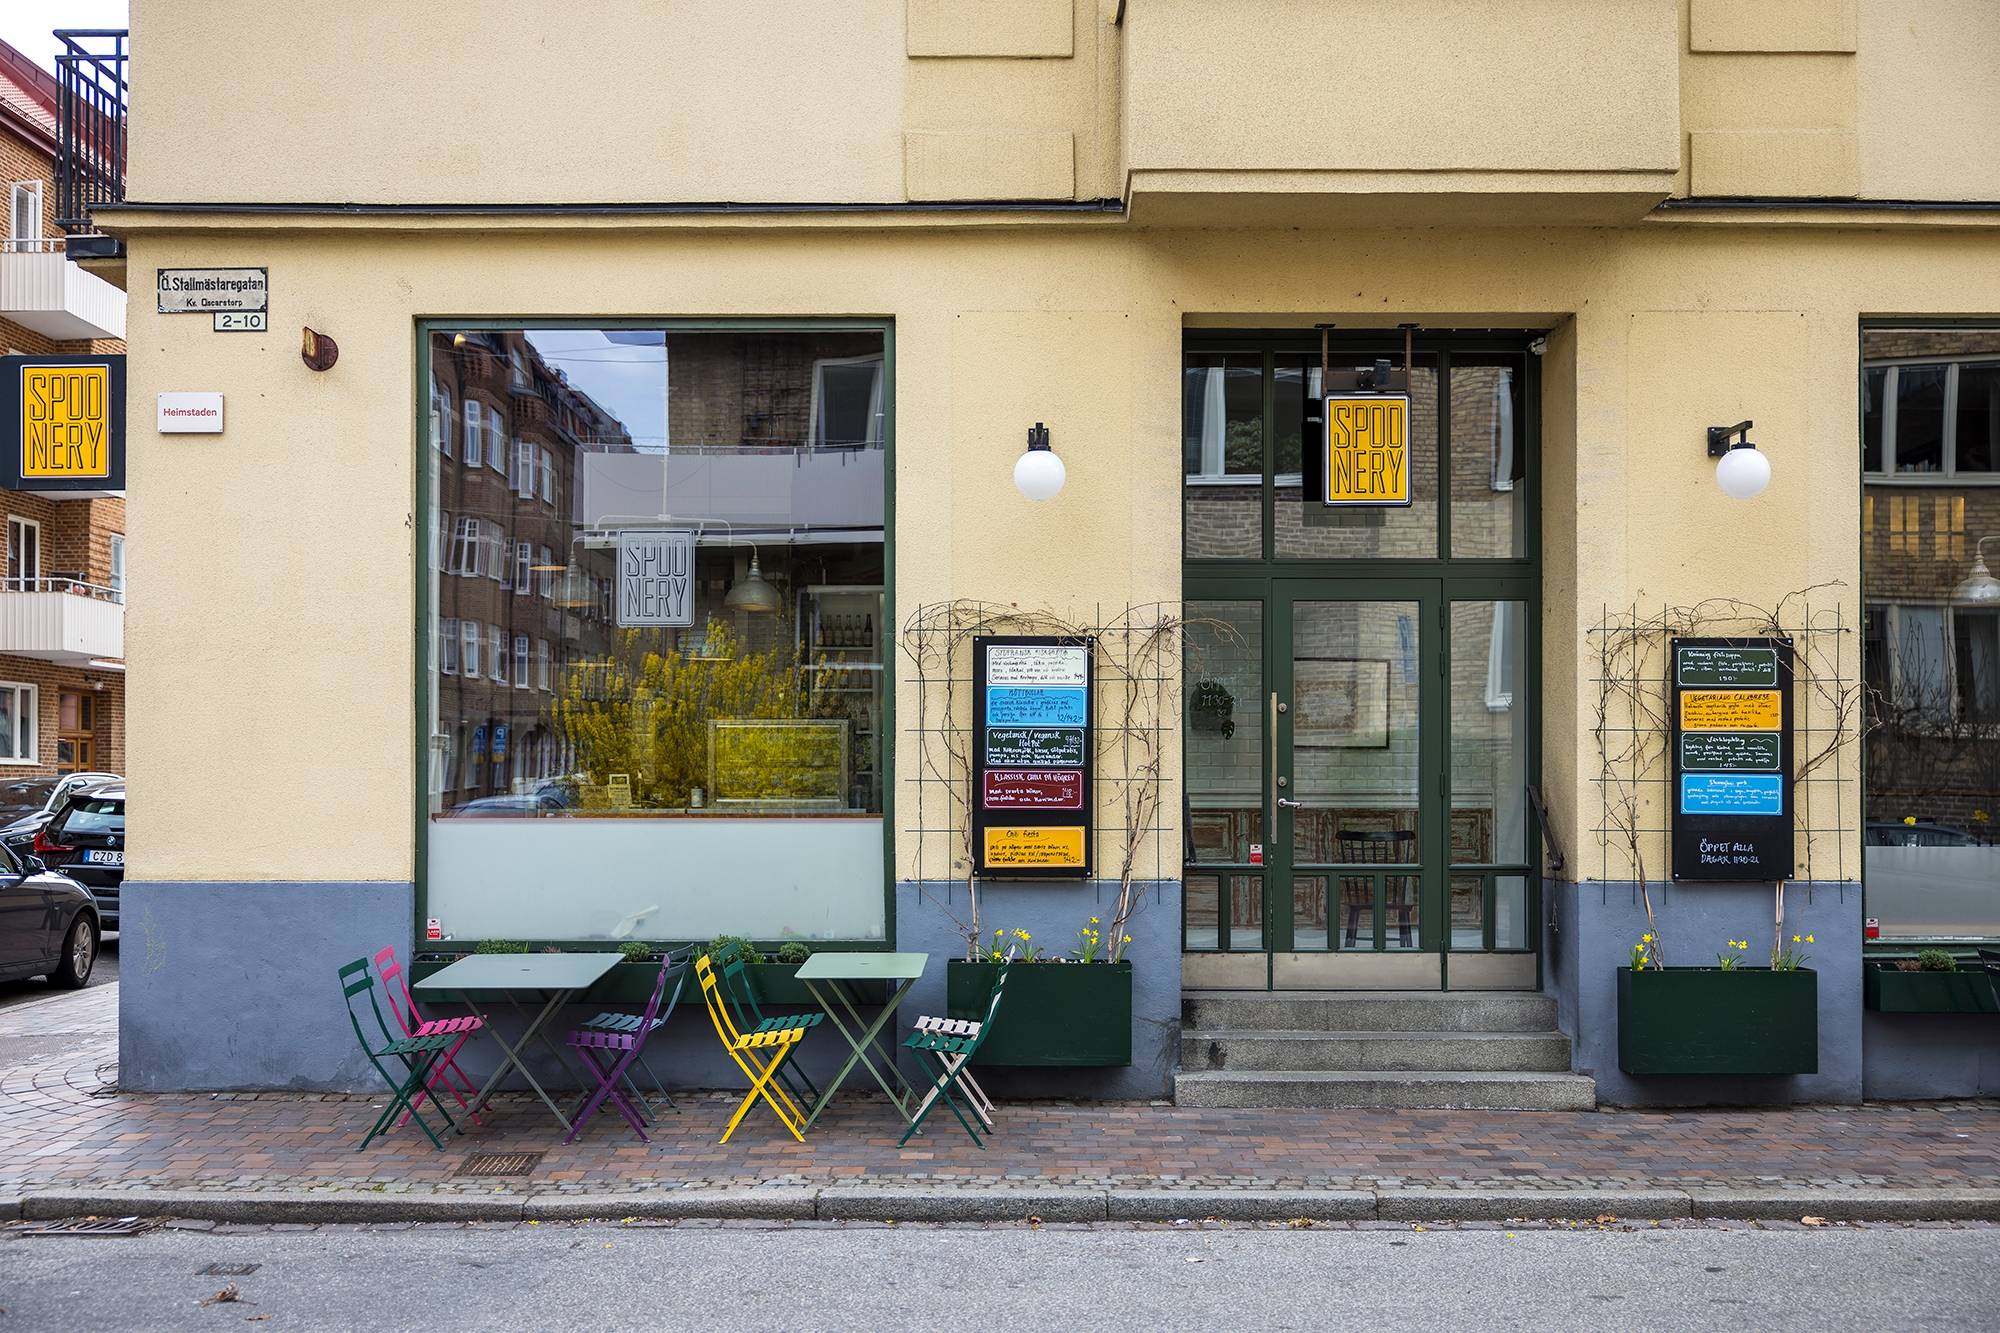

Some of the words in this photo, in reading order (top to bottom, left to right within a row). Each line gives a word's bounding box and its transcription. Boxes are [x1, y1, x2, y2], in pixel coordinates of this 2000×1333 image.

[201, 298, 243, 308] Oscarstorp
[222, 315, 261, 328] 2-10
[30, 374, 102, 421] SPOO
[163, 407, 217, 417] Heimstaden
[29, 422, 103, 469] NERY
[1334, 405, 1403, 449] SPOO
[1334, 450, 1404, 494] NERY
[625, 537, 687, 577] SPOO
[625, 578, 687, 617] NERY
[93, 851, 114, 861] CZD
[116, 852, 124, 862] 8
[1699, 837, 1731, 853] ÖPPET
[1732, 841, 1754, 852] ALLA
